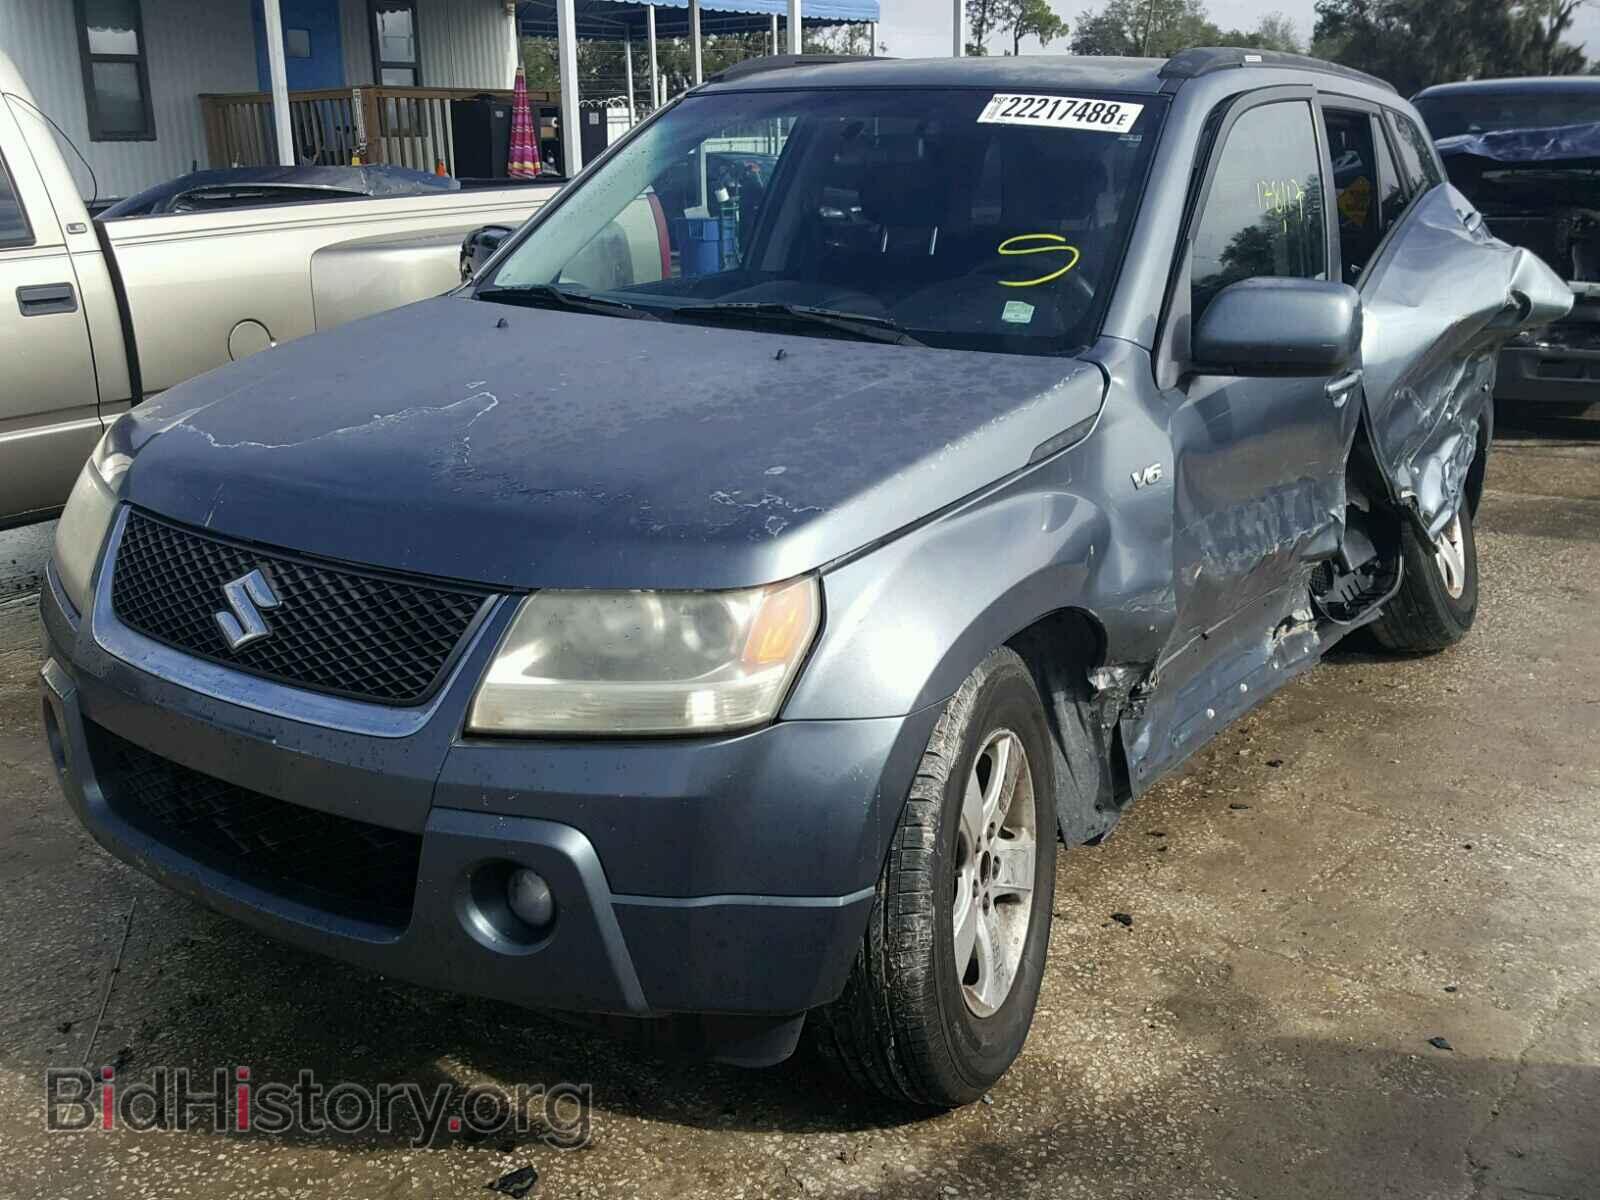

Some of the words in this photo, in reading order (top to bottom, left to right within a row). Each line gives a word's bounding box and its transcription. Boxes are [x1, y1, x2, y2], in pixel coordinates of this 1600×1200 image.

[1000, 96, 1121, 125] 22217488
[1116, 113, 1128, 126] E
[997, 233, 1079, 287] S
[1130, 463, 1162, 490] V6
